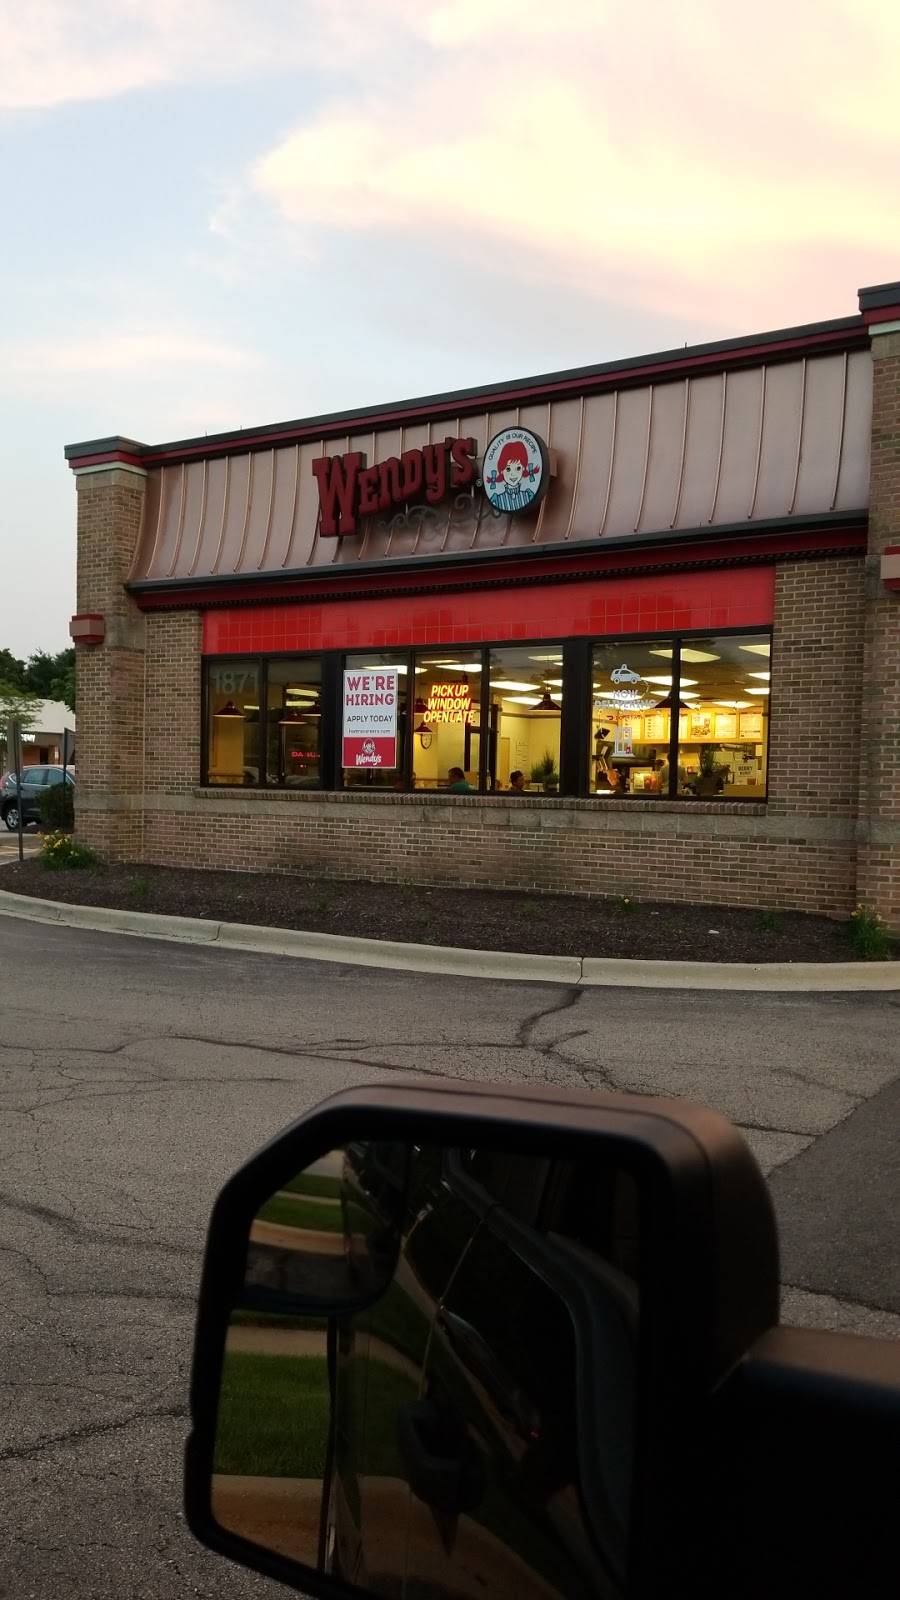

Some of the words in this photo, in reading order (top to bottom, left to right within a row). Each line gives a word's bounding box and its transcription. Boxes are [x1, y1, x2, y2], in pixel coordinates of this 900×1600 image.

[488, 438, 505, 460] QUALITY
[511, 432, 523, 441] OUR
[523, 435, 538, 454] RECIPE
[346, 675, 395, 691] WE'RE
[345, 693, 395, 706] HIRING
[613, 689, 639, 699] NOW
[427, 697, 471, 710] WINDOW
[346, 715, 369, 723] APPLY
[369, 715, 393, 723] TODAY
[423, 710, 450, 723] OPEN
[449, 710, 474, 723] LATE
[355, 751, 382, 766] Wendy's
